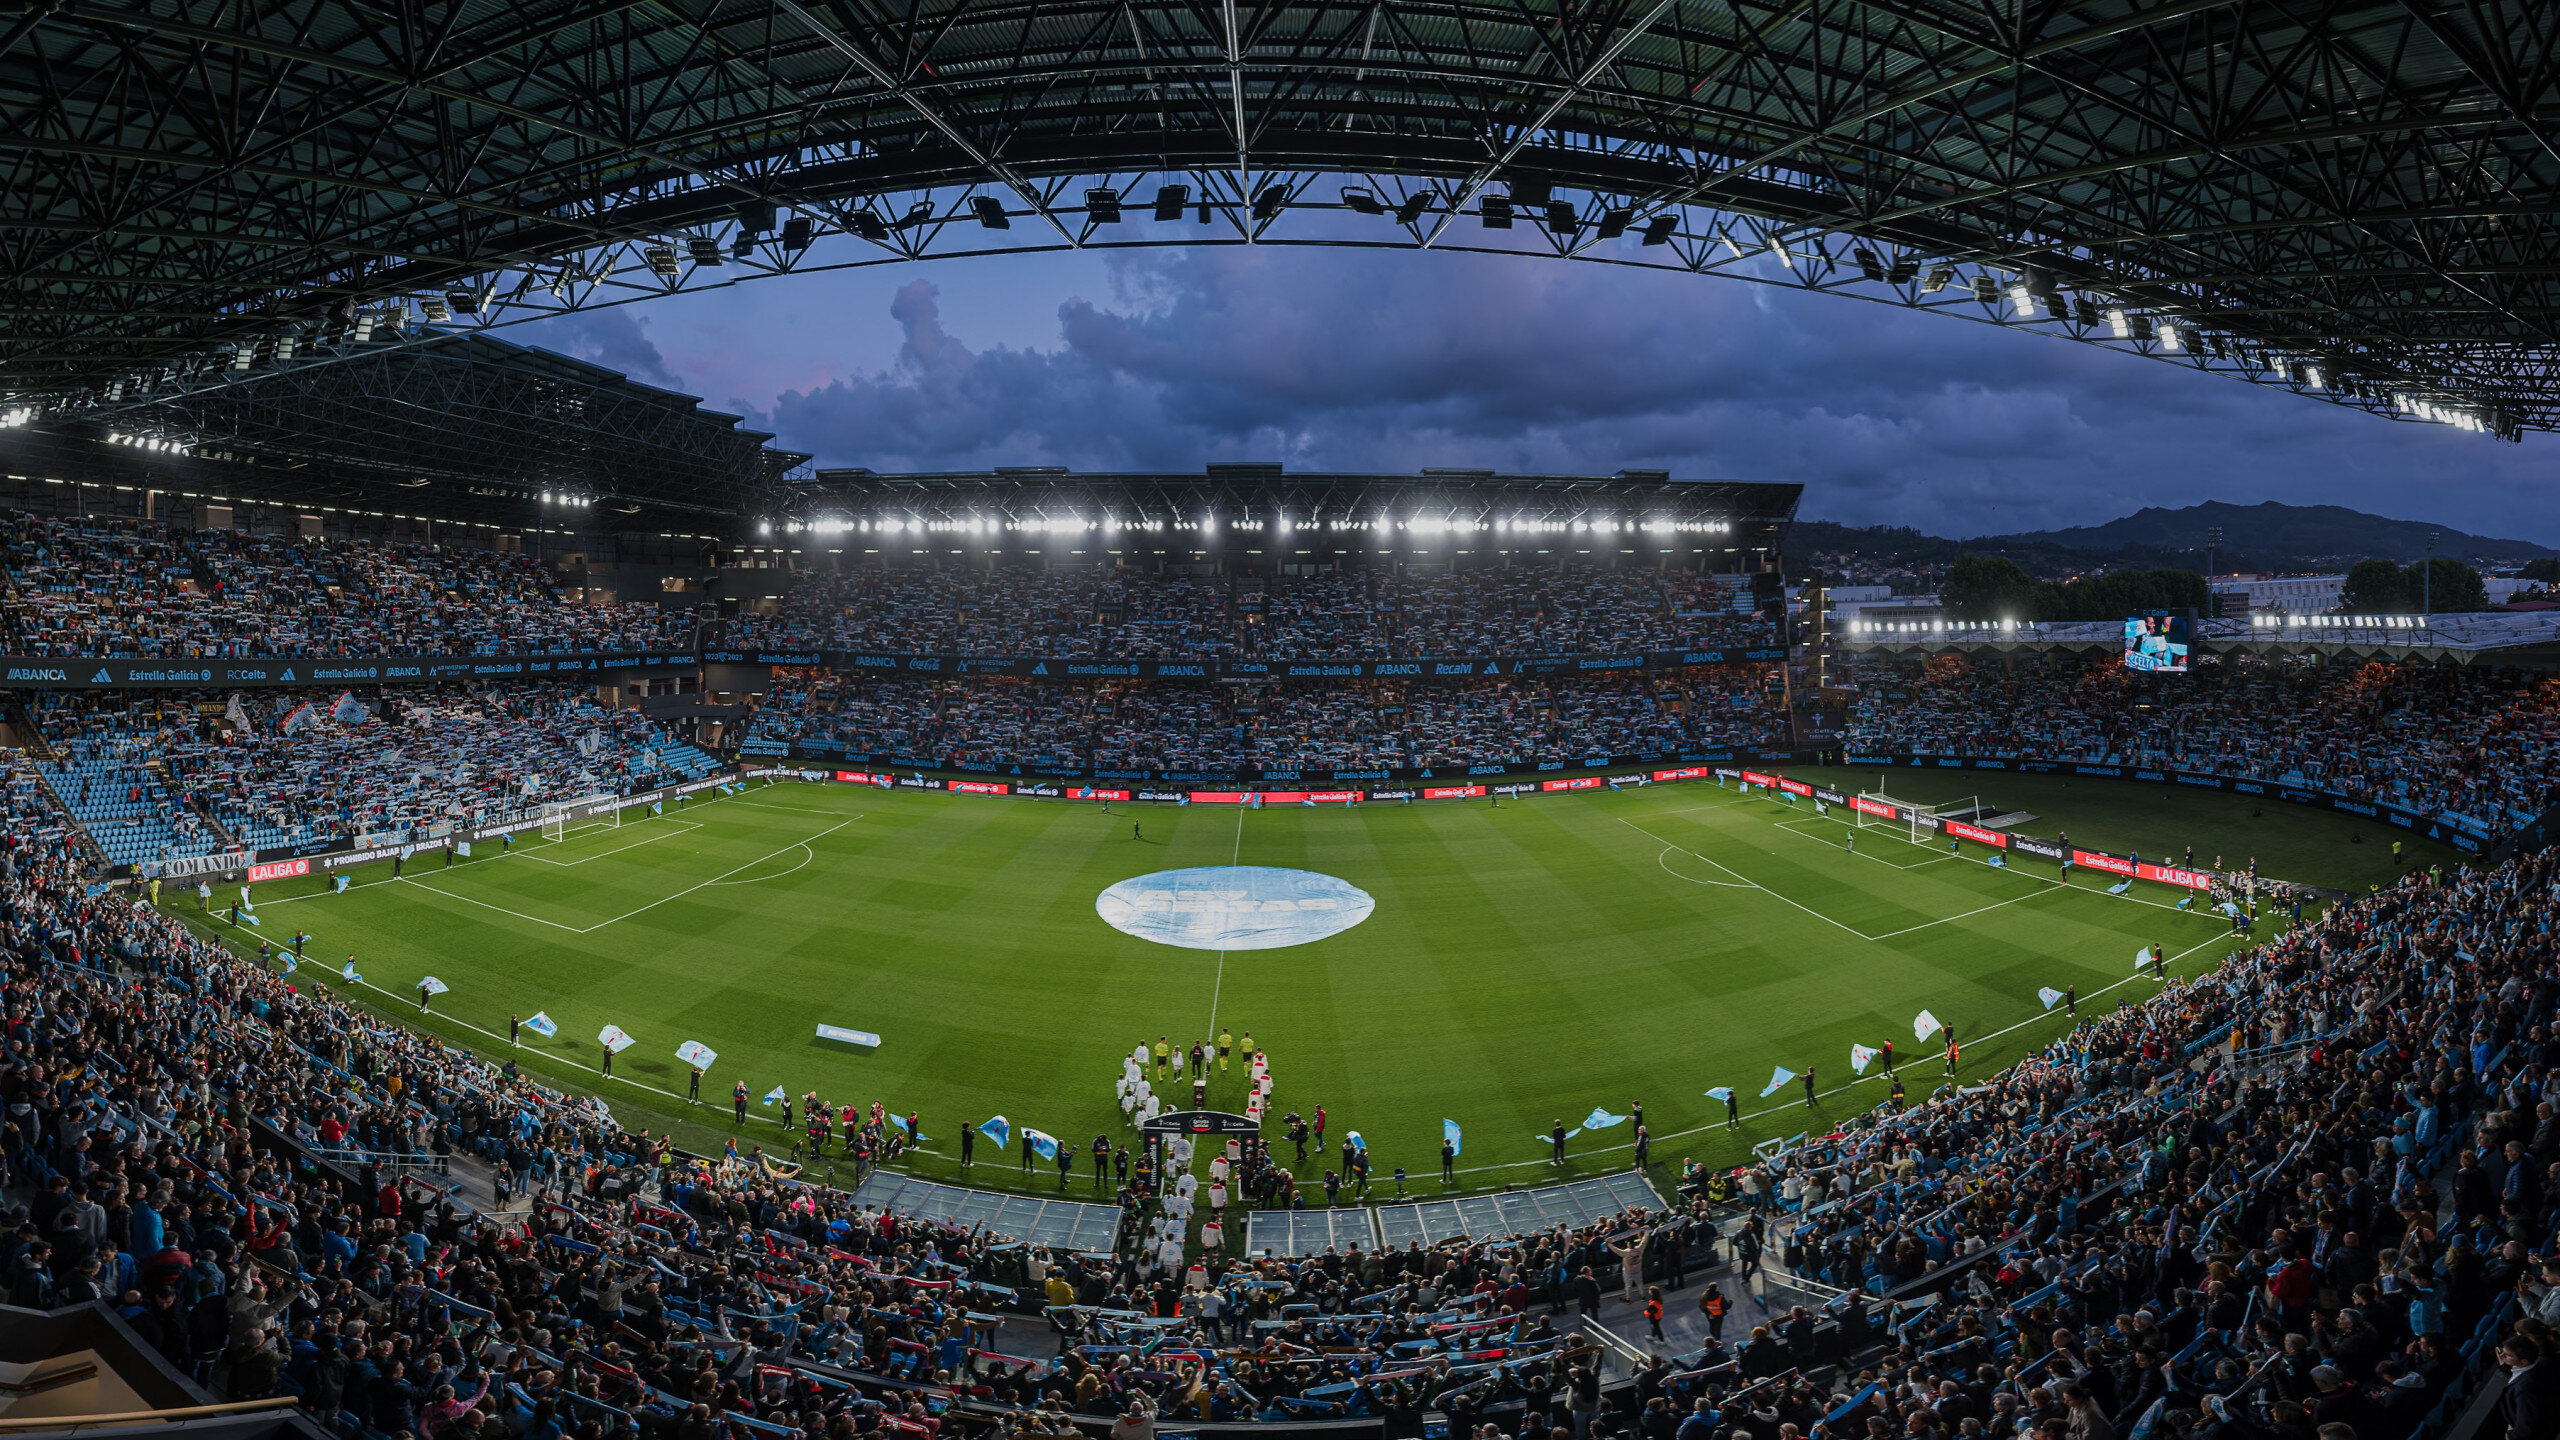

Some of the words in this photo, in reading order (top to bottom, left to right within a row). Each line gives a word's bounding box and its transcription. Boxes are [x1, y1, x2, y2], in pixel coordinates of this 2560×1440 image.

[757, 654, 784, 664] Estrella
[129, 669, 165, 681] Estrella
[167, 669, 199, 681] Galicia
[227, 669, 267, 680] RCCelta
[314, 669, 342, 679] Estrella
[342, 668, 368, 679] Galicia
[1068, 665, 1099, 675] Estrella
[1100, 665, 1128, 675] Galicia
[1289, 665, 1321, 676] Estrella
[1322, 665, 1351, 676] Galicia
[1435, 663, 1472, 675] Recalvi
[740, 747, 760, 756] Estrella
[1584, 758, 1610, 767] GADIS
[481, 825, 513, 838] PROHIBIDO
[514, 820, 533, 832] BAJAR
[533, 818, 545, 828] LOS
[334, 850, 375, 866] PROHIBIDO
[376, 847, 399, 859] BAJAR
[416, 839, 443, 852] BRAZOS
[2016, 840, 2035, 853] Estrella
[2036, 844, 2055, 857] Galicia
[163, 855, 245, 877] COMANDO
[2086, 855, 2109, 869] Estrella
[2109, 859, 2131, 874] Galicia
[252, 862, 293, 881] LALIGA
[2156, 865, 2194, 886] LALIGA
